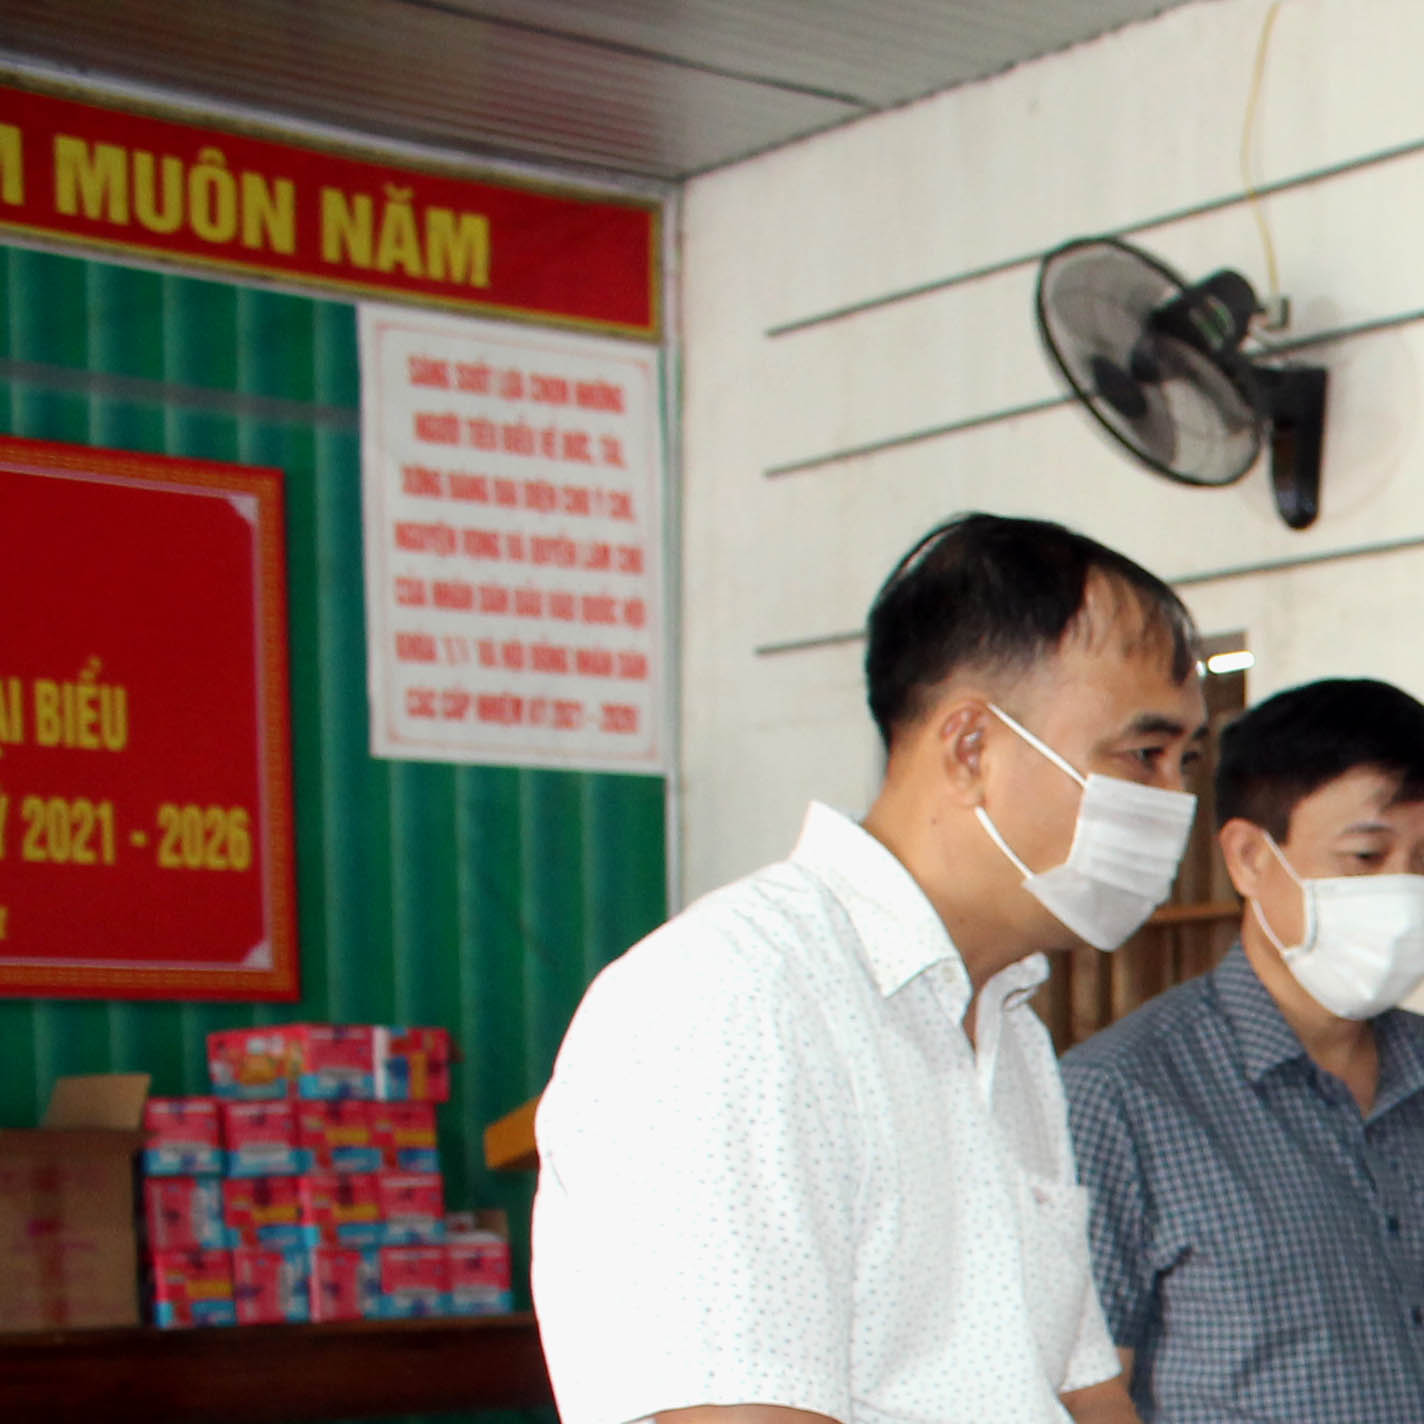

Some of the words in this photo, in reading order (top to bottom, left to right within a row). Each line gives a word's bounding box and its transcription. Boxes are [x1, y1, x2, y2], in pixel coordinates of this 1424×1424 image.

[54, 133, 296, 255] MUÔN
[320, 181, 491, 288] NĂM
[35, 655, 128, 751] BIỂU
[22, 795, 116, 866] 2021
[157, 803, 253, 872] 2026
